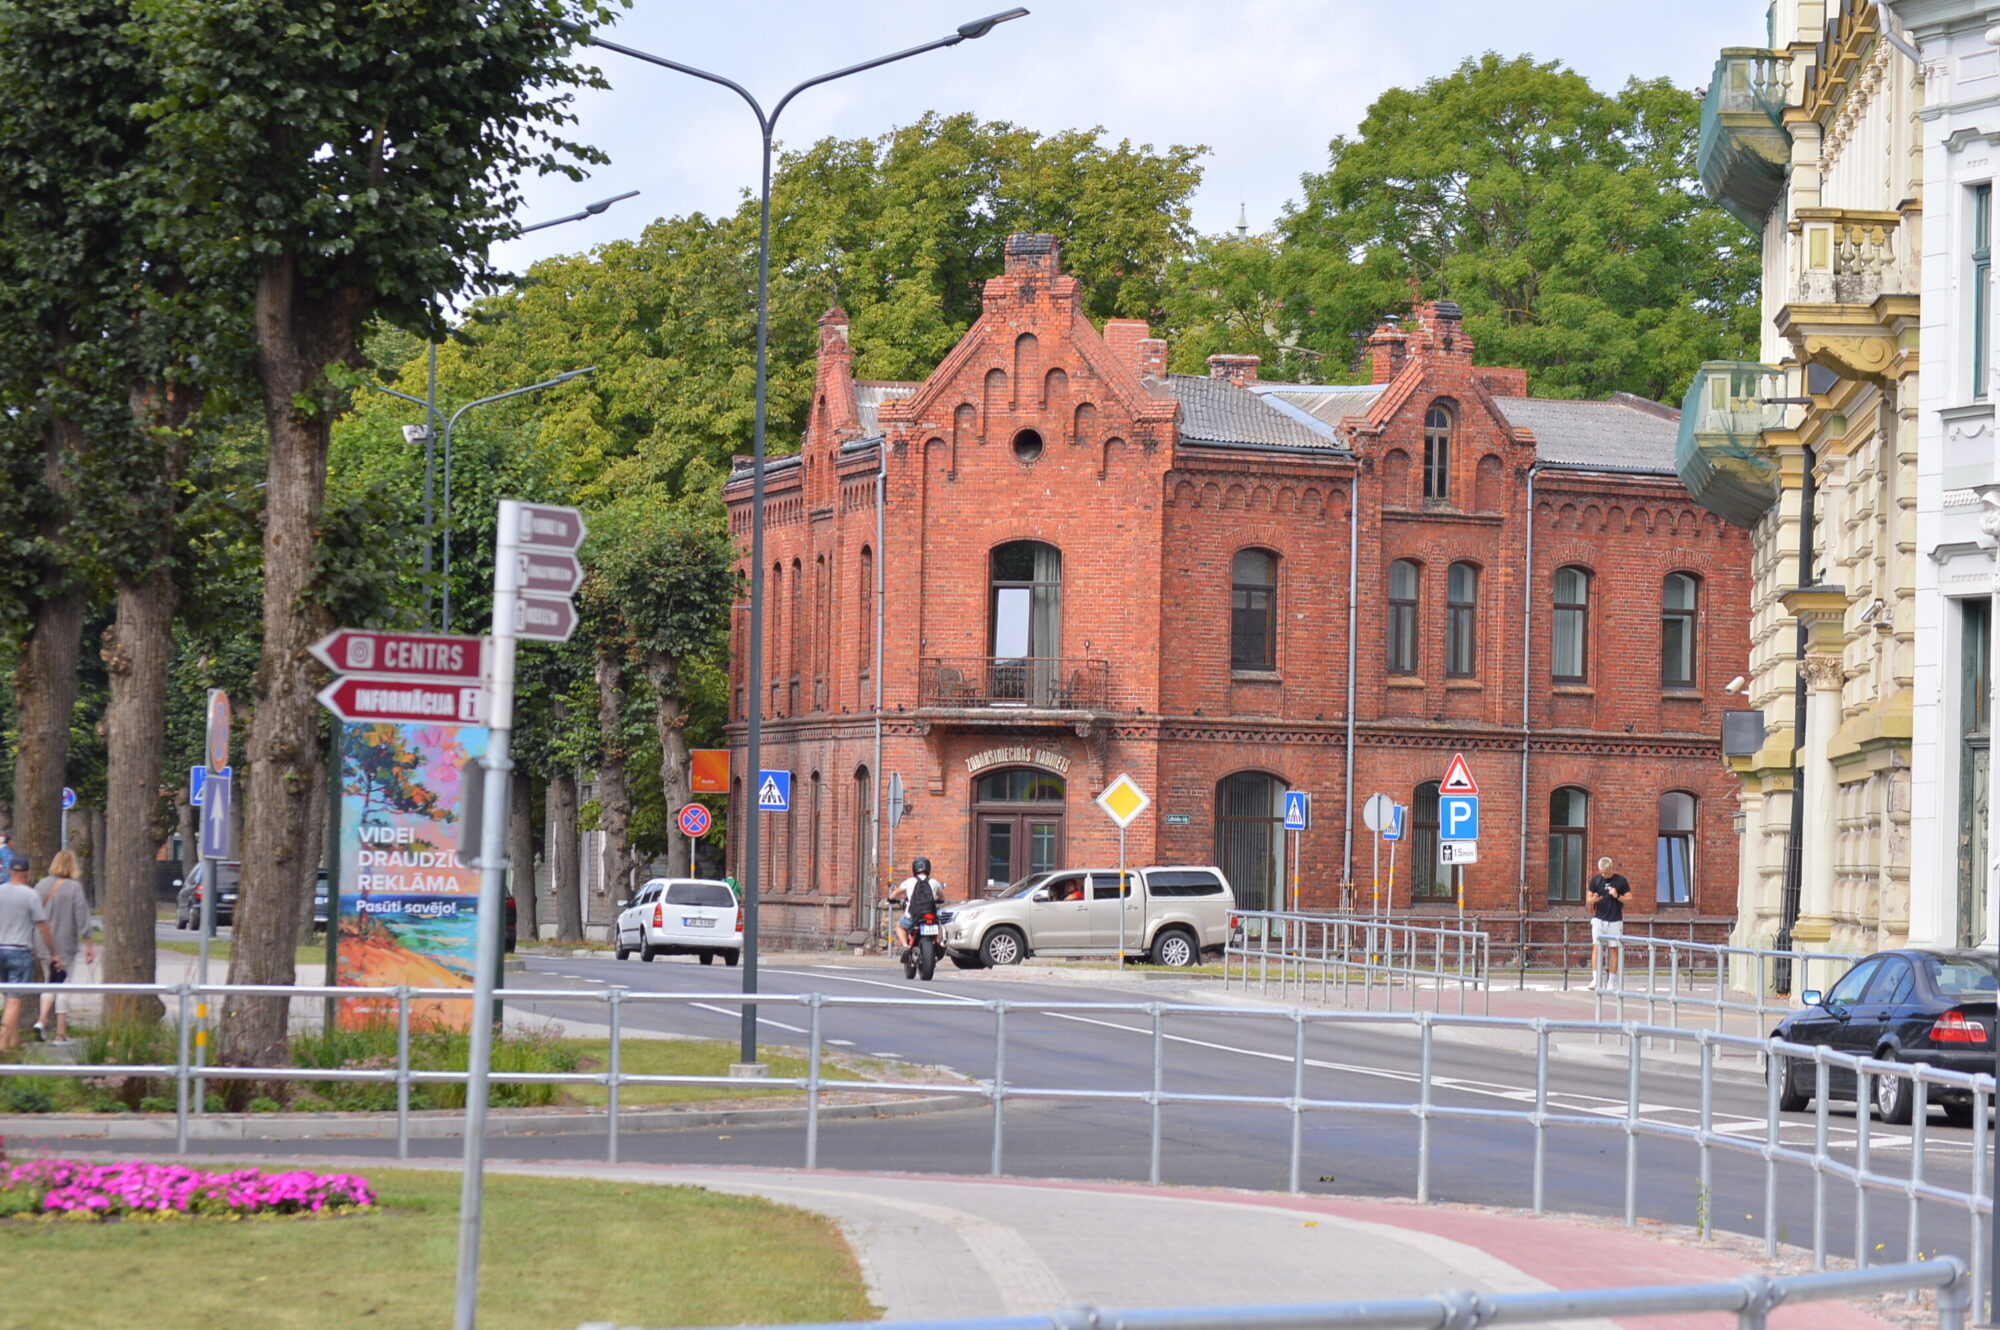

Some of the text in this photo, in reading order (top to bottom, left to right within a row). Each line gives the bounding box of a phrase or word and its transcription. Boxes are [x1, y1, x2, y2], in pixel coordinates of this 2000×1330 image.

[384, 641, 464, 671] CENTRS
[355, 688, 455, 716] INFORMĀCIJA
[1450, 801, 1471, 835] P
[358, 827, 415, 843] VIDEI
[358, 872, 460, 892] REKLĀMA
[355, 900, 456, 916] Pasūti savējo!
